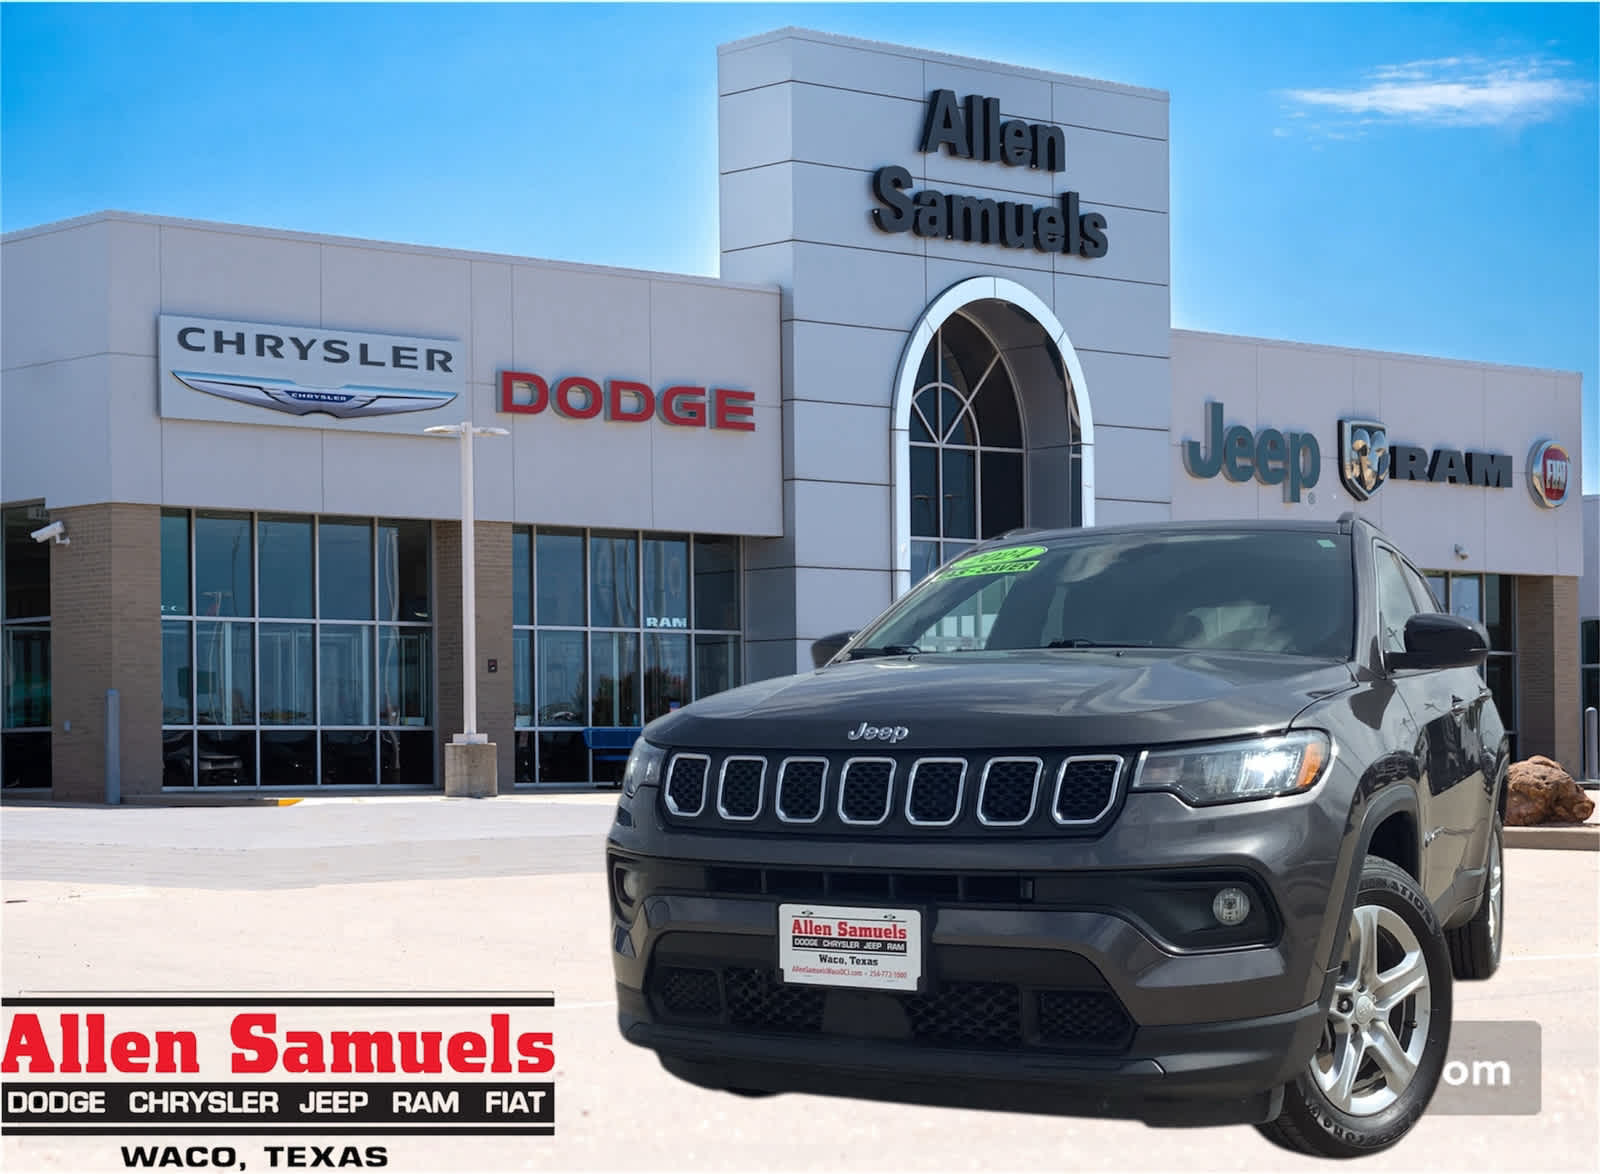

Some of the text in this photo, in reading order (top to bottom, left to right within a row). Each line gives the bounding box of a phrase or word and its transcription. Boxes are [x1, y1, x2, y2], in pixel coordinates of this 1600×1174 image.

[918, 88, 1066, 172] Allen
[872, 165, 1108, 258] Samuels
[177, 327, 454, 373] CHRYSLER
[290, 391, 347, 402] CHRYSLER
[496, 370, 755, 432] DODGE
[1183, 401, 1321, 503] Jeep
[1389, 444, 1513, 488] RAM
[646, 616, 687, 628] RAM
[848, 722, 909, 743] Jeep
[792, 919, 907, 940] Allen Samuels
[794, 938, 905, 951] DODGE CHRYSLER JEEP RAM
[819, 954, 878, 966] Waco, Texas
